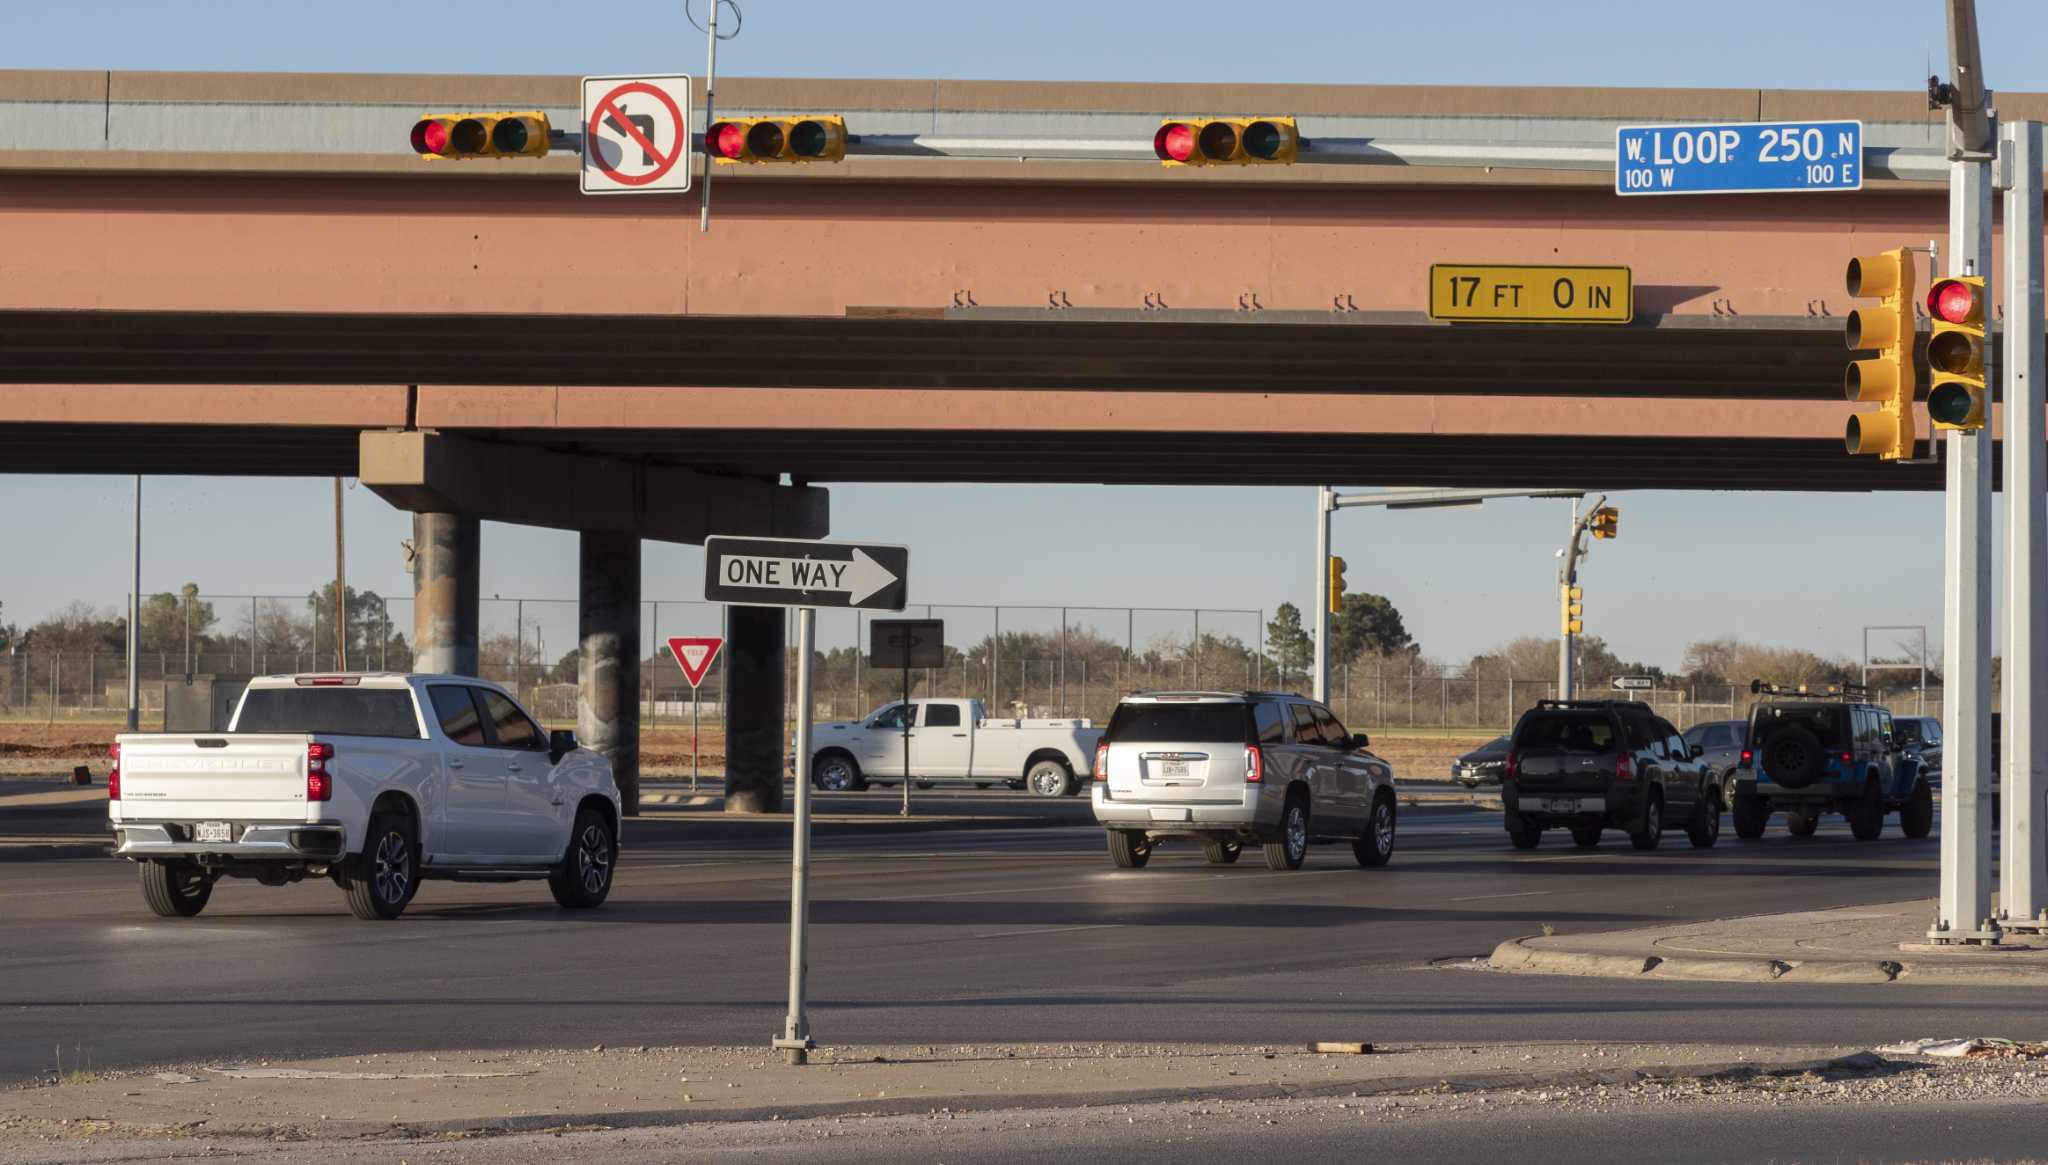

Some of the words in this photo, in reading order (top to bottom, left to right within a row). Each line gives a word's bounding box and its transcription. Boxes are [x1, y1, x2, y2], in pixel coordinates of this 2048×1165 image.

[1654, 130, 1741, 165] LOOP
[1758, 128, 1823, 163] 250
[1625, 169, 1653, 188] 100
[1660, 168, 1675, 187] W
[1806, 164, 1834, 184] 100
[1842, 164, 1853, 183] E
[1449, 276, 1481, 308] 17
[1494, 284, 1524, 308] FT
[1553, 277, 1575, 309] 0
[1588, 285, 1611, 309] IN
[727, 558, 781, 585] ONE
[791, 561, 848, 588] WAY
